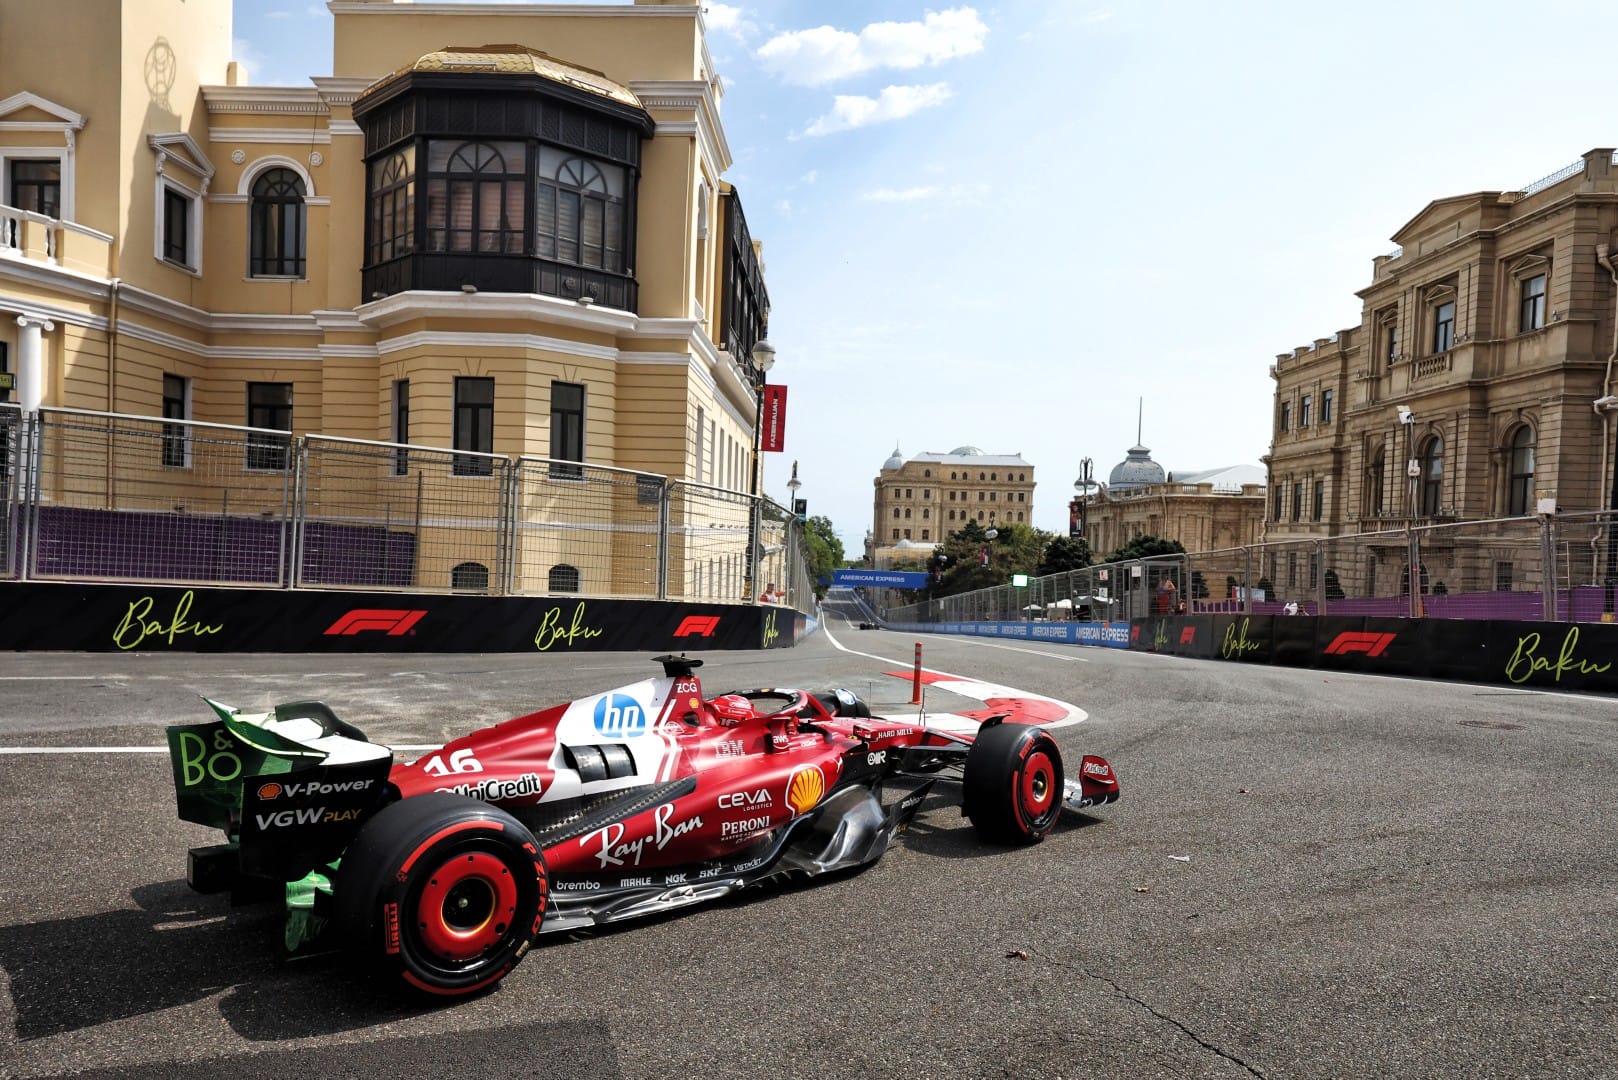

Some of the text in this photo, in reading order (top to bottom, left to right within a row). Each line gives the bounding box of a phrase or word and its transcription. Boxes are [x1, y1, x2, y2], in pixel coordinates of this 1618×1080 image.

[113, 590, 224, 649] Baku
[535, 601, 603, 650] Baku
[1075, 627, 1129, 643] AMERICAN EXPRESS
[1222, 617, 1260, 659] Baku
[1505, 626, 1612, 684] Baku
[602, 694, 640, 739] hp
[772, 735, 789, 744] aws
[897, 727, 913, 736] MILLE
[179, 729, 243, 787] B&O
[715, 740, 745, 758] IBM
[423, 748, 483, 777] 16
[284, 779, 374, 798] V-Power
[255, 806, 362, 831] VGW PLAY
[743, 802, 773, 812] LOGISTICS
[721, 815, 770, 836] PERONI
[522, 842, 547, 935] P ZERO
[556, 880, 601, 890] brembo
[620, 877, 652, 888] MAHLE
[665, 873, 687, 885] NGK
[384, 902, 400, 955] PIRELLI
